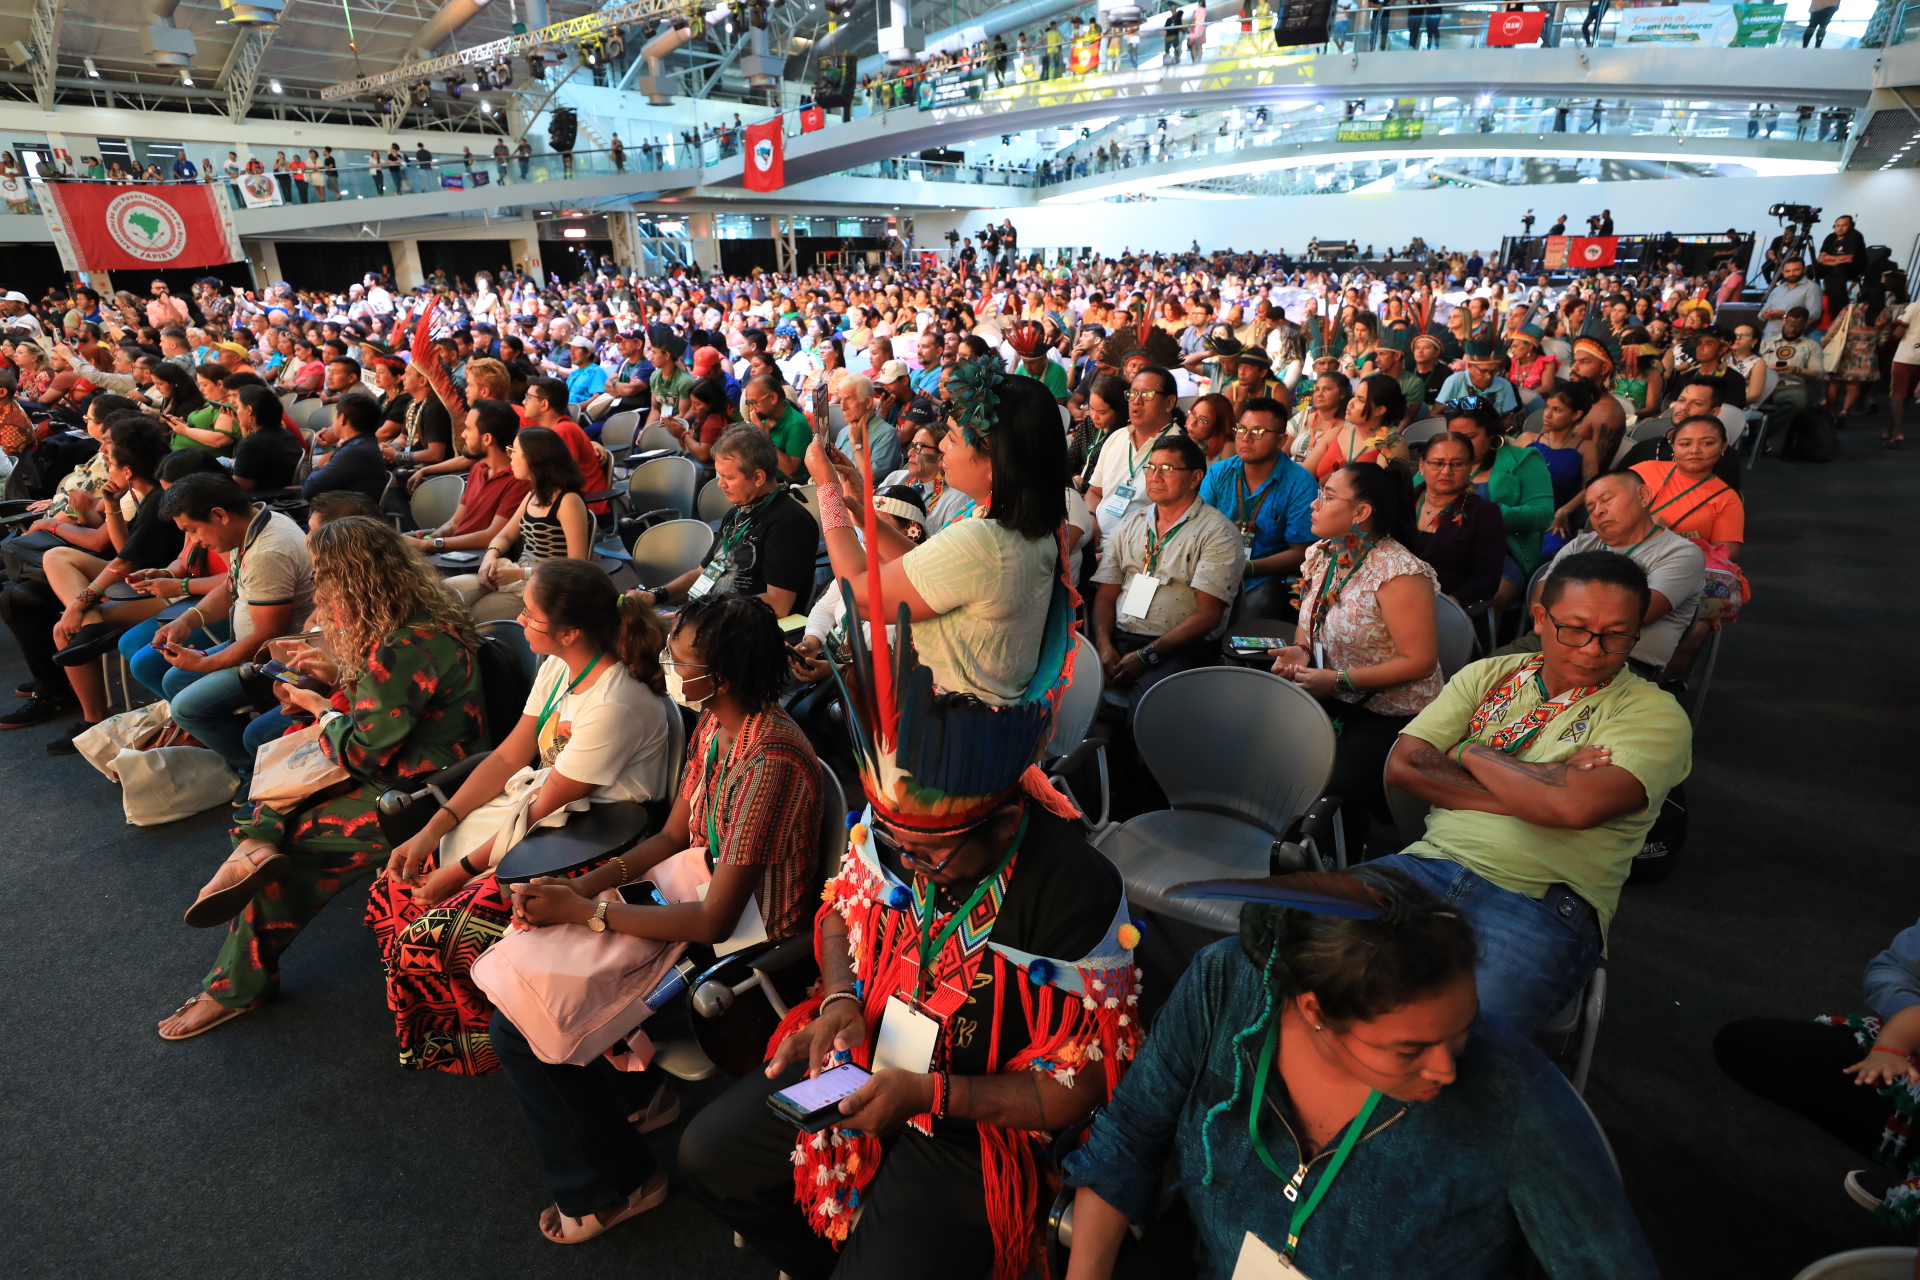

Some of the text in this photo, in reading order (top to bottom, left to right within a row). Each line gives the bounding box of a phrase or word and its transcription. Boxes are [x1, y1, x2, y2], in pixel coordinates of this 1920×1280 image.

[1633, 13, 1686, 24] Encontro de
[1750, 14, 1782, 23] HUMANA
[1631, 23, 1662, 31] Jovens
[121, 193, 143, 203] Povos
